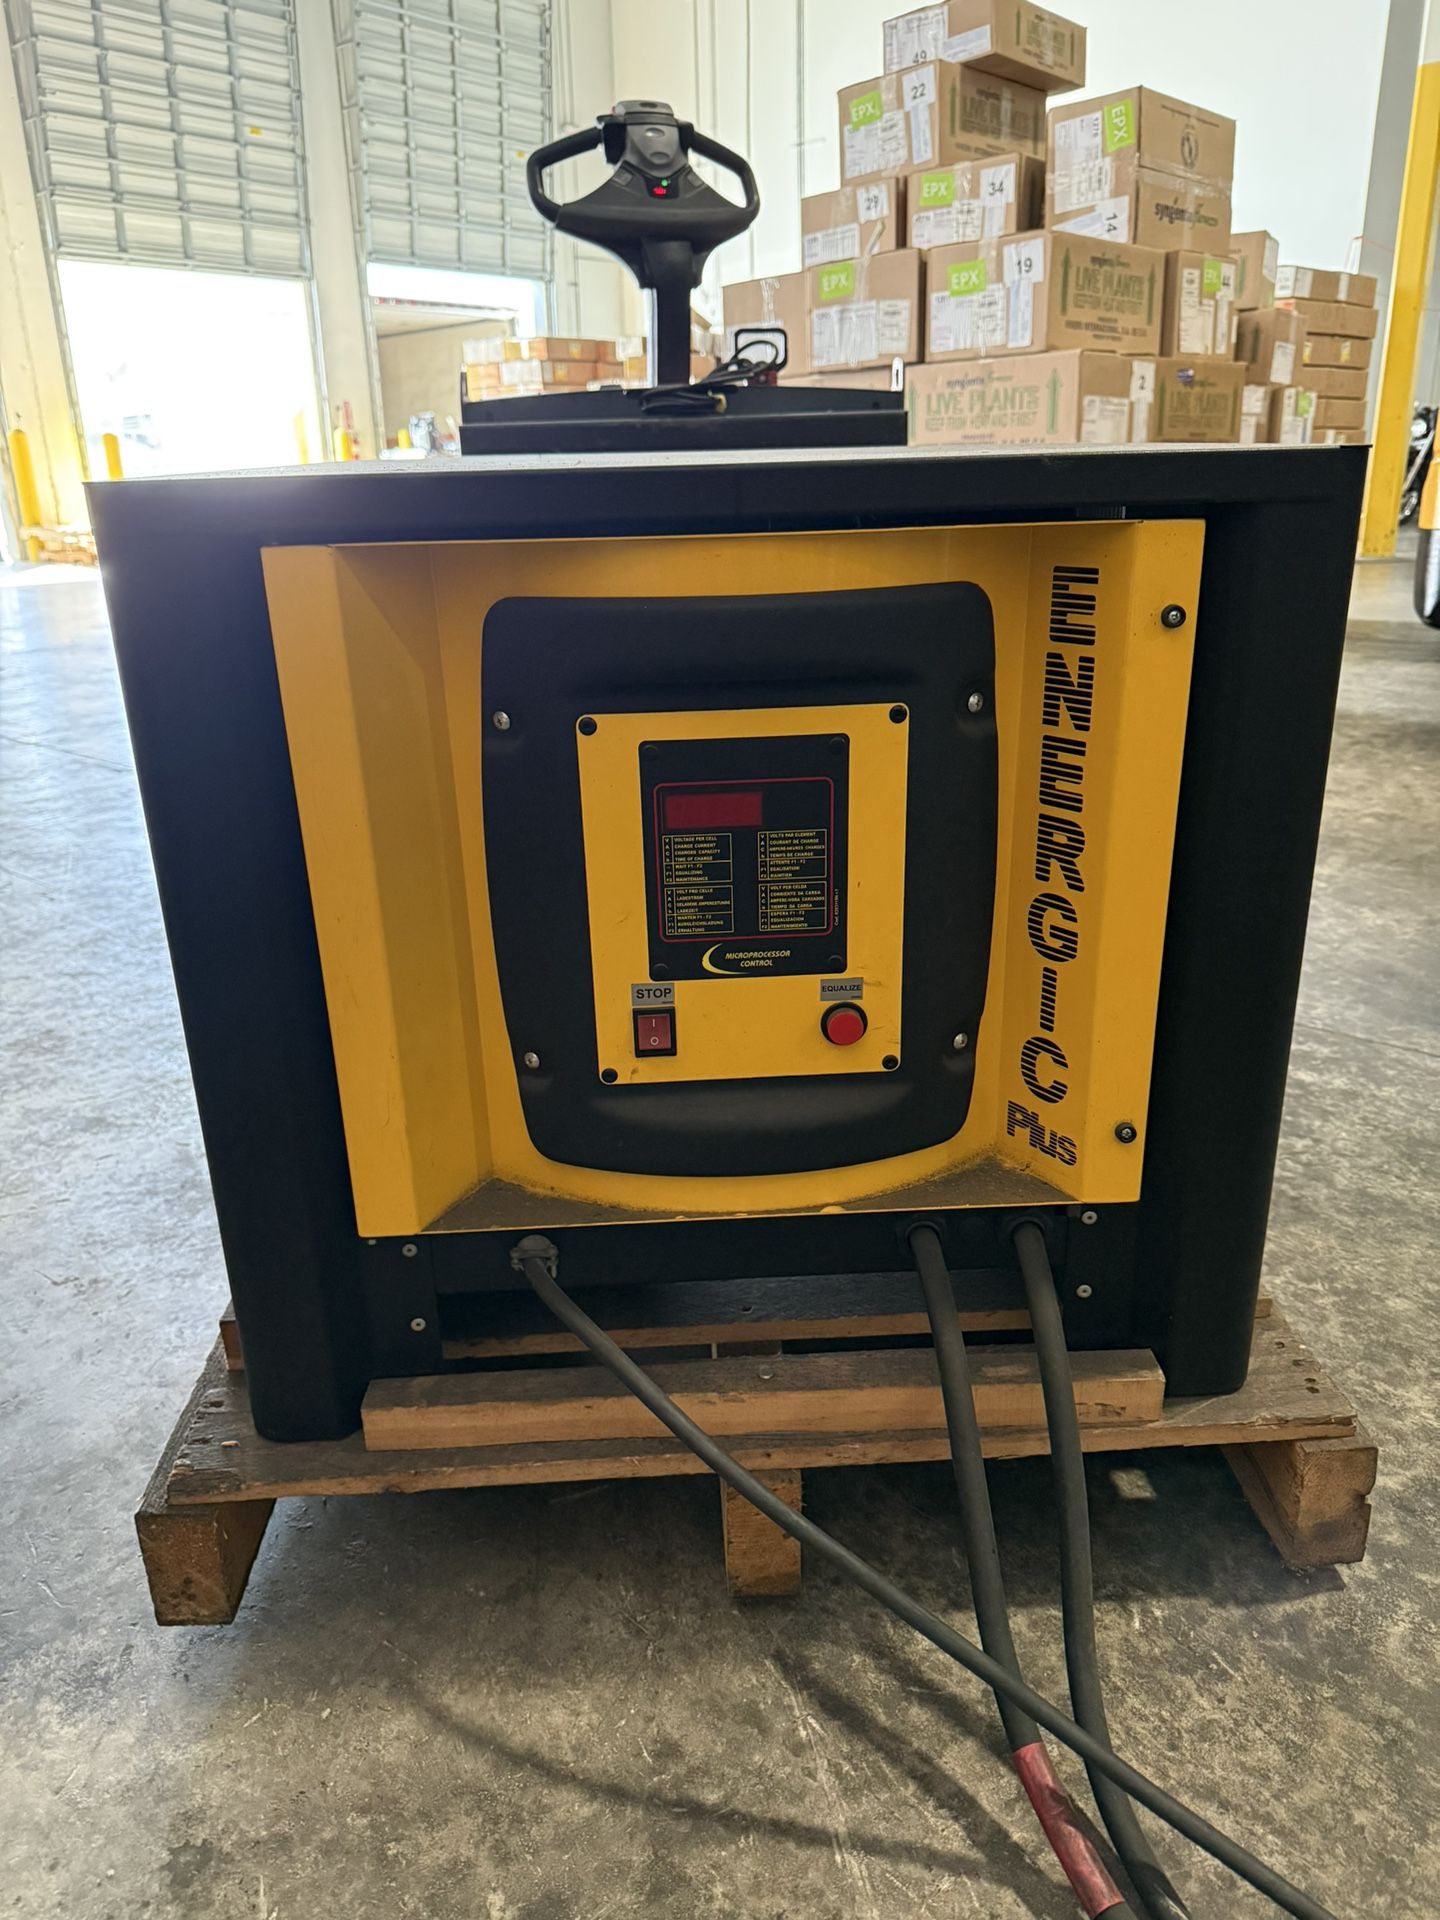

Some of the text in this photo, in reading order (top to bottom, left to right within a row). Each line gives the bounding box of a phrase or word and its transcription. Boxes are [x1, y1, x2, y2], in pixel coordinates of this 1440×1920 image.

[911, 83, 926, 100] 22
[852, 101, 874, 121] EPX
[1112, 105, 1128, 143] EPX
[923, 182, 948, 197] EPX
[989, 181, 1004, 196] 34
[1016, 257, 1032, 274] 19
[821, 272, 848, 292] EPX
[951, 269, 978, 289] EPX
[1139, 375, 1146, 390] 2
[926, 386, 1040, 416] LIVE PLANTS
[1020, 565, 1101, 1105] ENERGIC
[725, 950, 791, 960] MICROPROCESSOR
[636, 988, 672, 999] STOP
[822, 984, 863, 992] EQUALIZE
[1006, 1100, 1078, 1167] Plus
